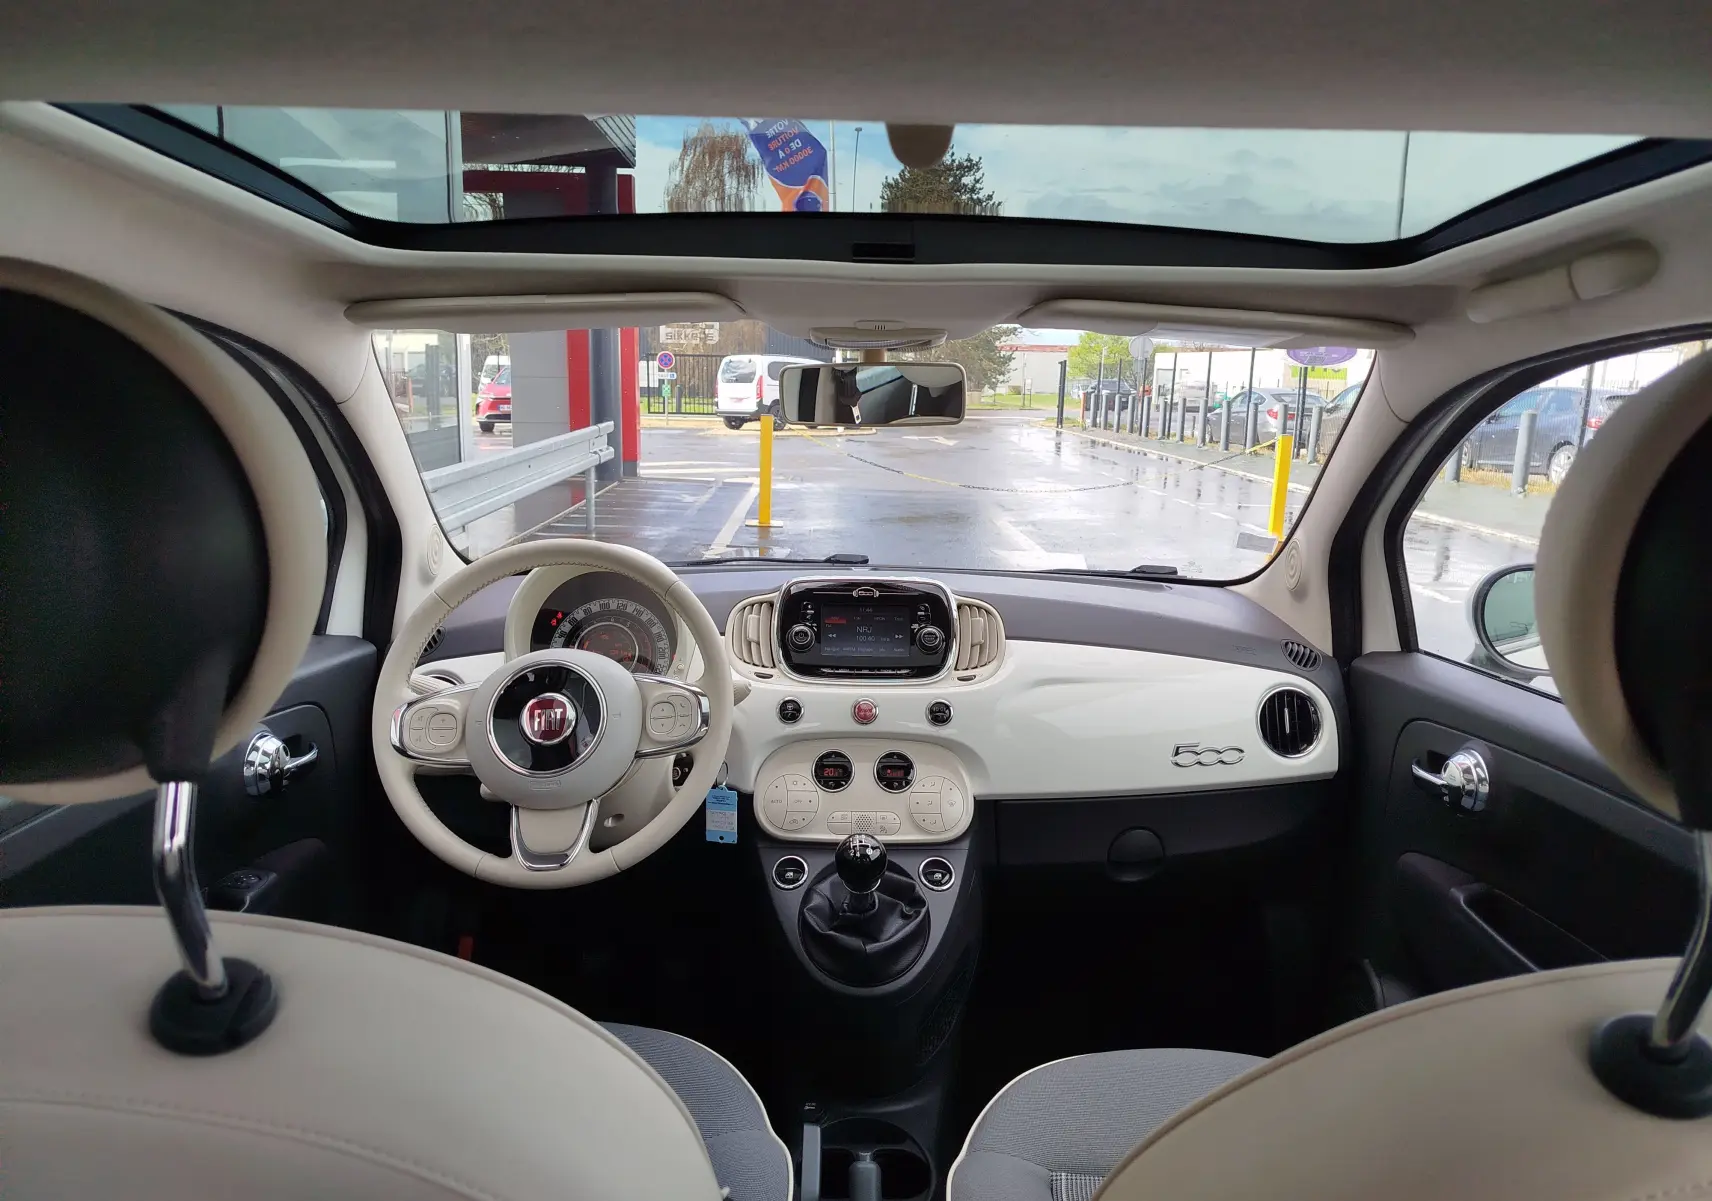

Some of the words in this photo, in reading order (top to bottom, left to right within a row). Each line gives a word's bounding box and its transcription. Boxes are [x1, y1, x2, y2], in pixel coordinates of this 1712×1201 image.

[665, 330, 714, 341] sikkes
[534, 708, 563, 731] FIAT
[1170, 742, 1247, 768] 500
